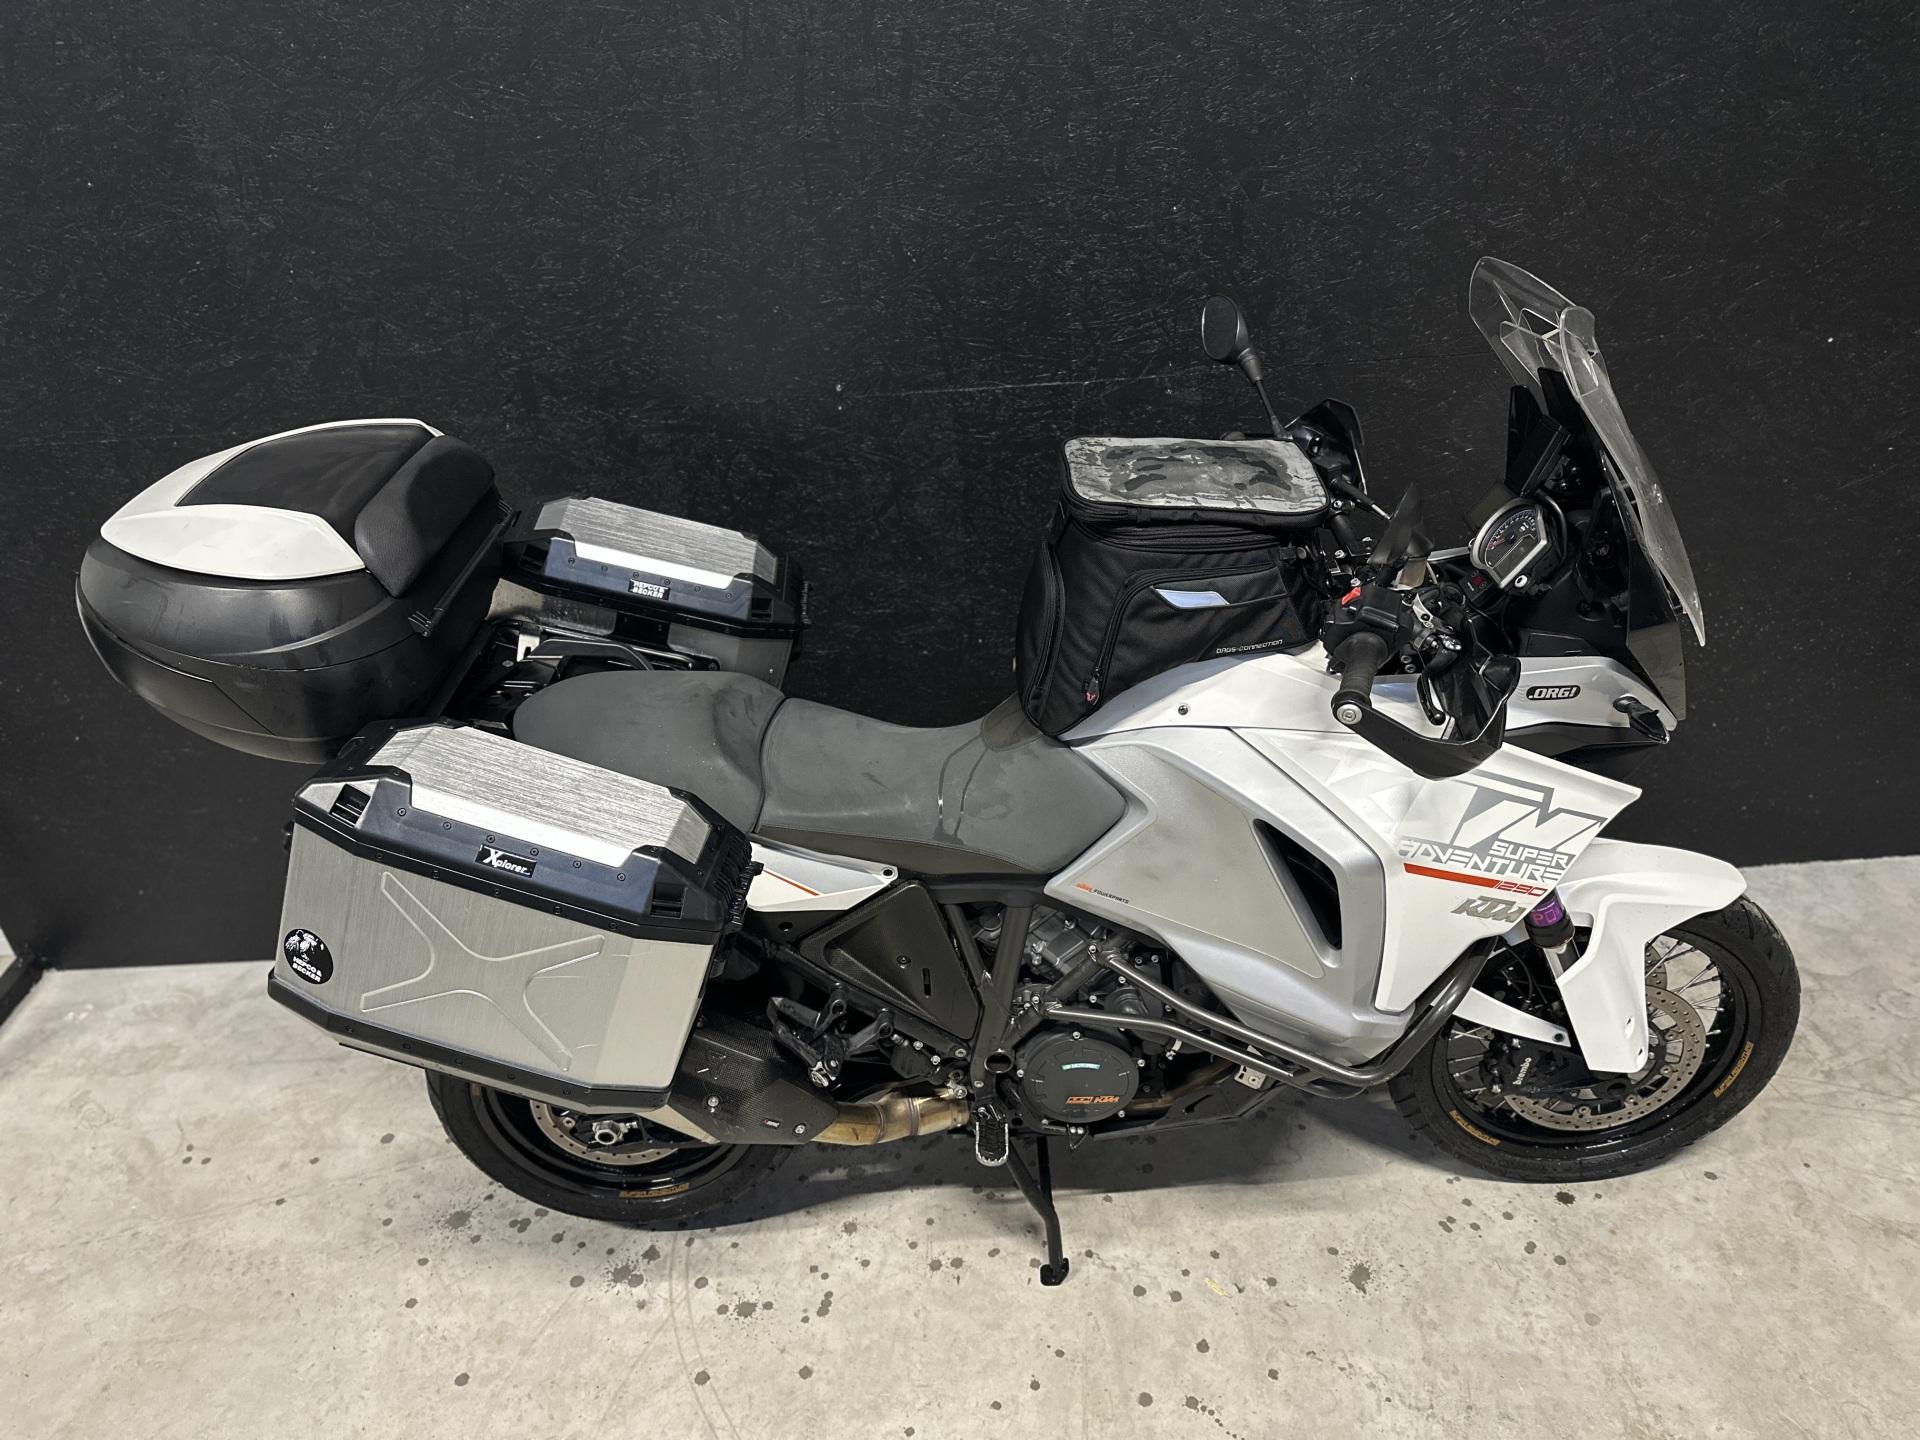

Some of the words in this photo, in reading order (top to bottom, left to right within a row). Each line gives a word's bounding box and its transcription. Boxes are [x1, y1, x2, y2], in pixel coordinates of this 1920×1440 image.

[482, 847, 530, 875] Xplorer
[1399, 839, 1565, 883] ADVENTURE
[1488, 841, 1571, 869] SUPER
[1493, 880, 1549, 897] 1290
[1450, 895, 1528, 924] KTM
[292, 962, 321, 983] BECKER
[1512, 1057, 1532, 1085] brembo
